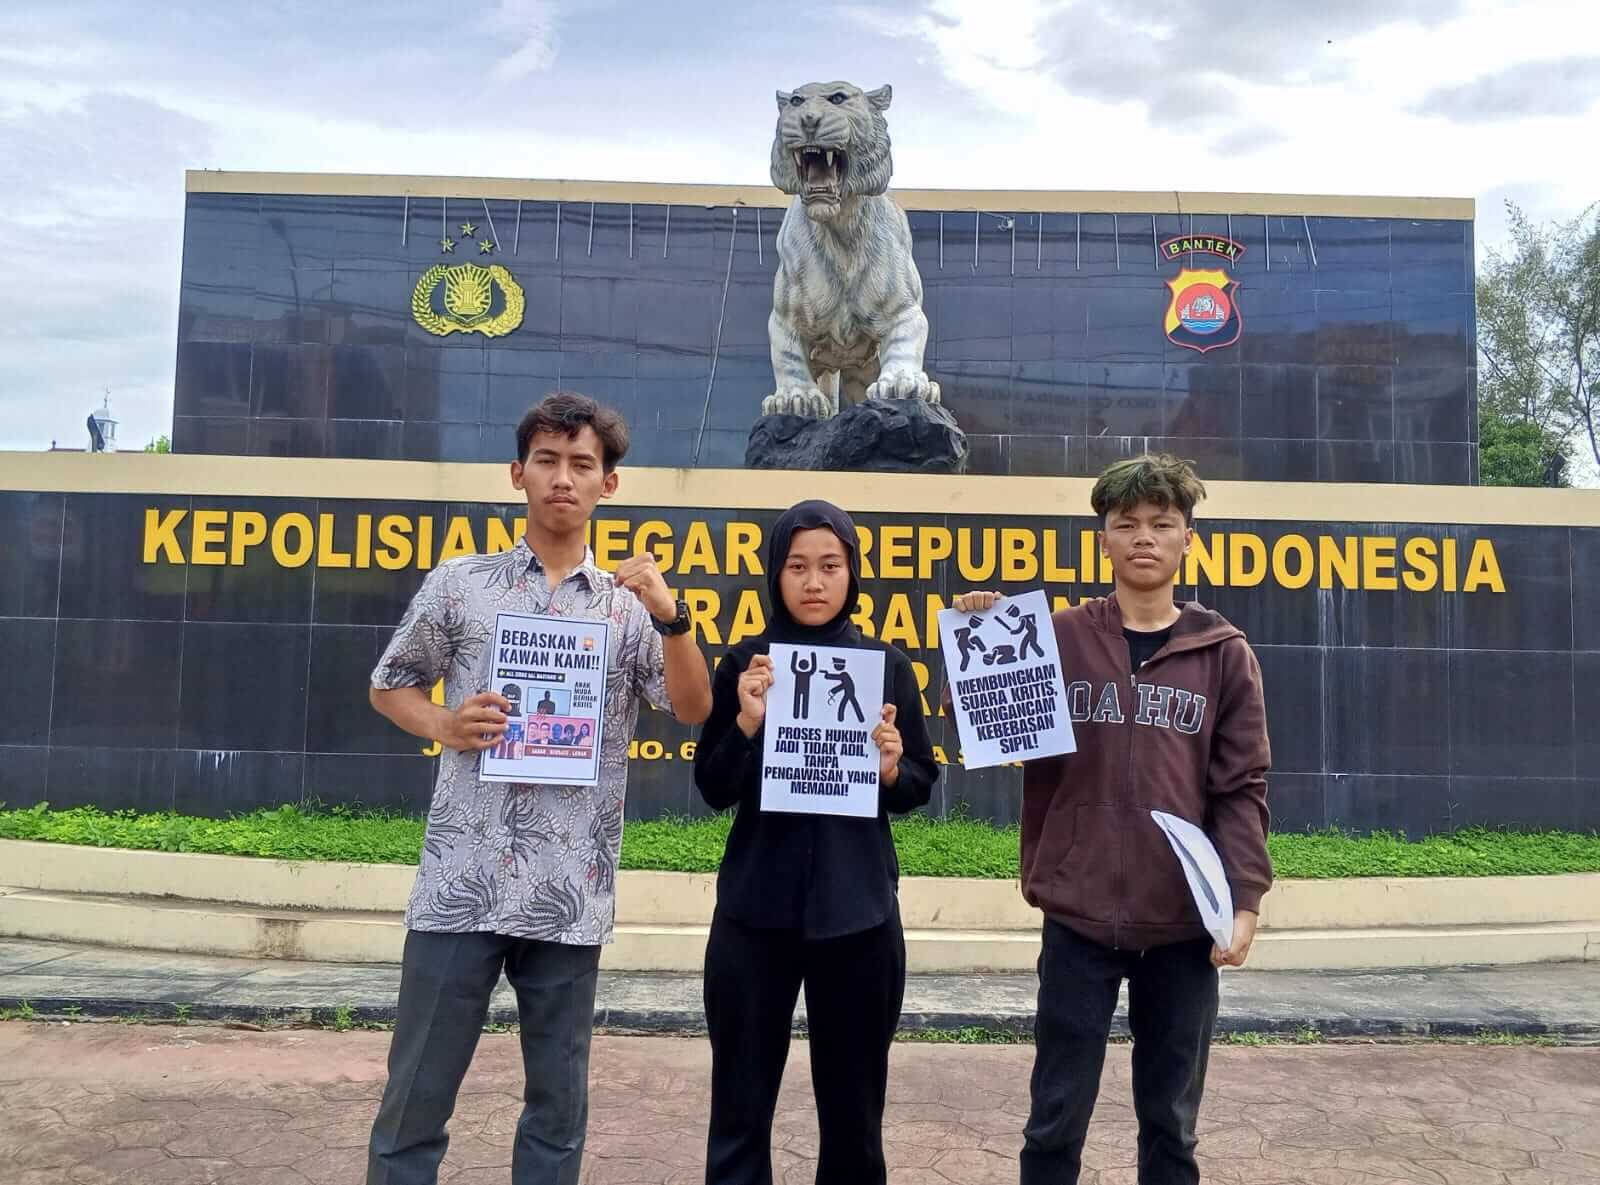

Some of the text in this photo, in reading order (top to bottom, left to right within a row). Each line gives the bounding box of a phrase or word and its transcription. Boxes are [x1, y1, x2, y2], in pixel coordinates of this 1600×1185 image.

[1169, 239, 1237, 256] BANTEN
[143, 509, 528, 570] KEPOLISIAN
[584, 519, 764, 576] EGAR
[1172, 532, 1505, 593] NDONESIA
[501, 629, 577, 651] BEBASKAN
[499, 648, 601, 670] KAWAN KAMI!!
[956, 663, 1057, 697] MEMBUNGKAM
[960, 681, 1058, 712] SUARA KRITIS,
[968, 697, 1057, 727] MENGANCAM
[778, 727, 868, 744] PROSES HUKUM
[976, 715, 1055, 742] KEBEBASAN
[774, 740, 869, 758] JADI TIDAK ADIL,
[999, 733, 1039, 754] SIPIL!
[804, 755, 839, 768] TANPA
[764, 767, 877, 785] PENGAWASAN YANG
[790, 782, 849, 796] MEMADAI!
